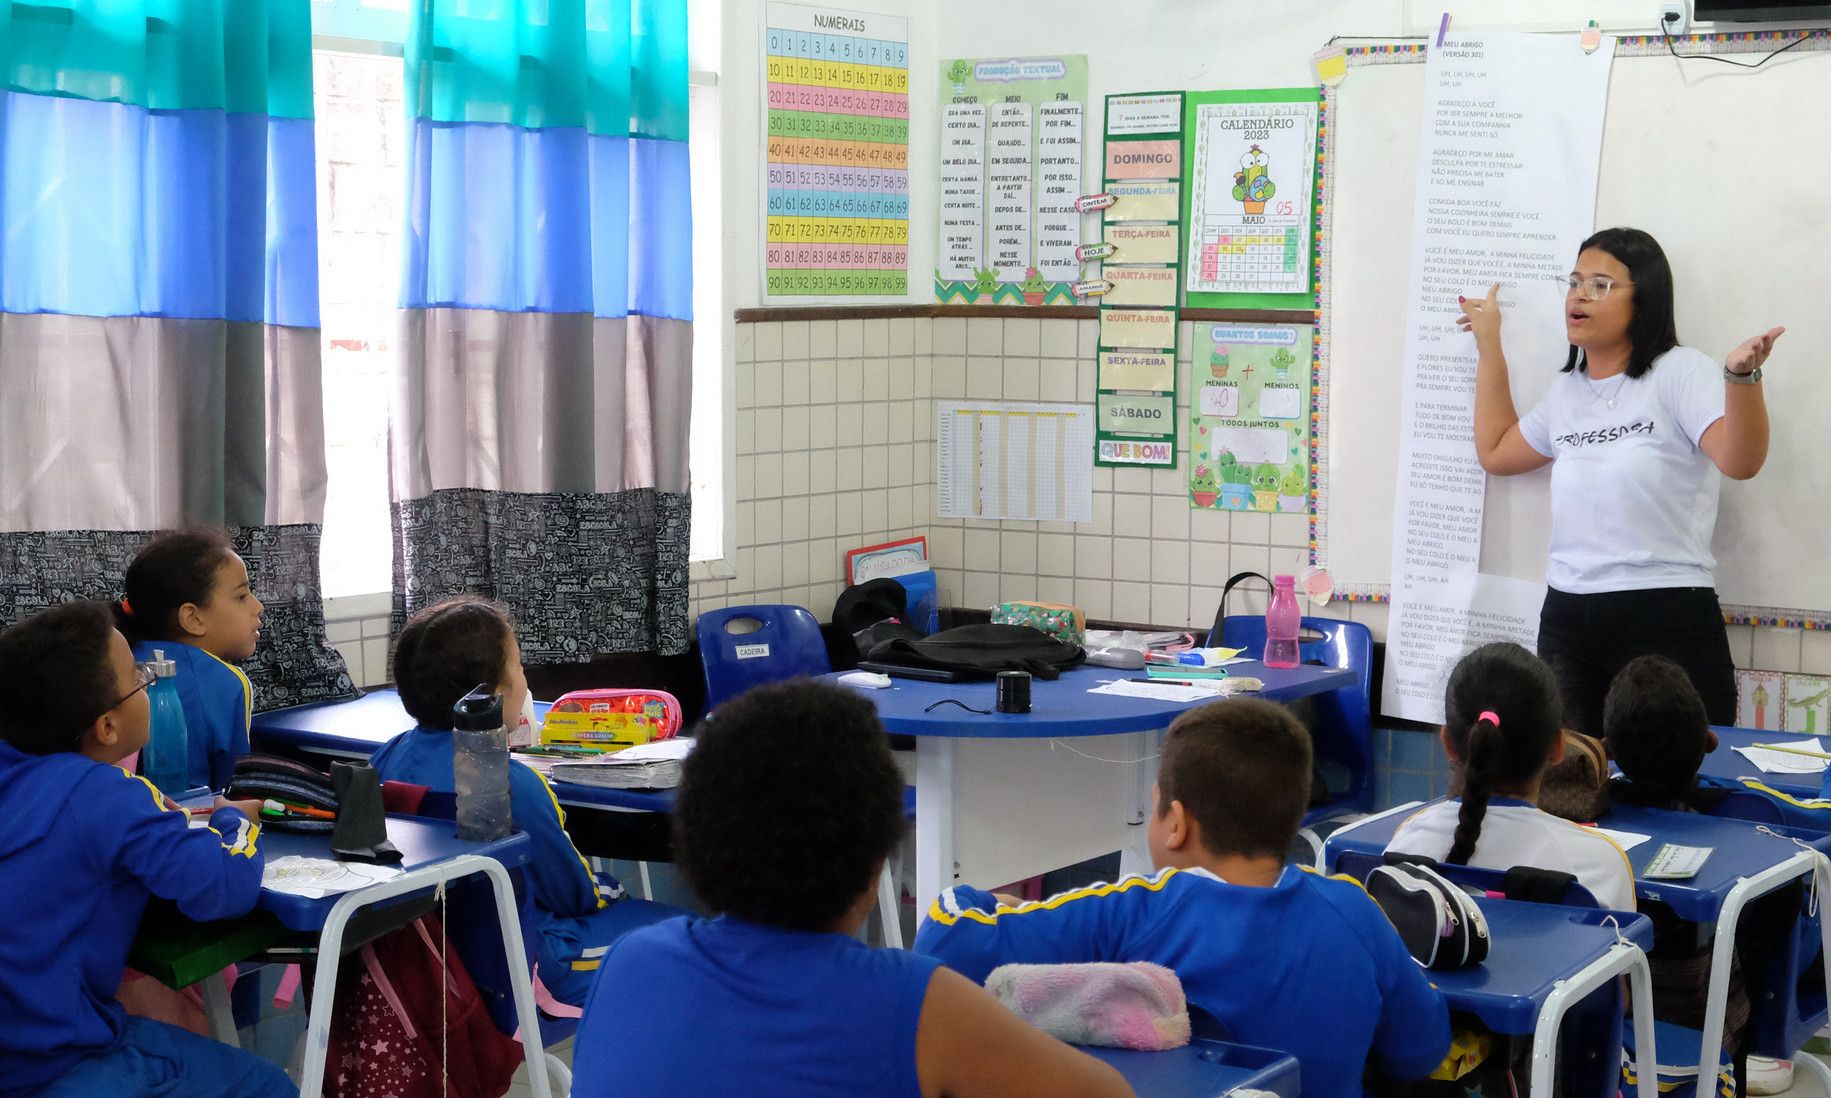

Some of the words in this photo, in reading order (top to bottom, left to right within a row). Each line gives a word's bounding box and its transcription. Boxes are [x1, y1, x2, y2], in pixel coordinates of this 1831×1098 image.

[814, 14, 865, 31] NUMERAIS
[772, 37, 777, 49] 0
[788, 39, 791, 50] 1
[802, 40, 806, 52] 2
[816, 42, 820, 53] 3
[830, 43, 834, 54] 4
[845, 44, 850, 56] 5
[858, 46, 863, 57] 6
[871, 48, 876, 59] 7
[885, 49, 890, 60] 8
[899, 51, 904, 62] 9
[1443, 50, 1469, 58] (VERSÃO
[978, 65, 1020, 76] PRODUÇÃO
[1023, 64, 1061, 74] TEXTUAL
[770, 64, 779, 76] 10
[786, 65, 793, 77] 11
[800, 67, 808, 78] 12
[815, 68, 822, 80] 13
[828, 69, 837, 81] 14
[843, 71, 851, 82] 15
[857, 72, 865, 84] 16
[870, 73, 878, 85] 17
[885, 75, 892, 86] 18
[897, 74, 905, 88] 19
[953, 96, 977, 104] COMEÇO
[1437, 100, 1470, 109] AGRADEÇO
[1479, 100, 1495, 108] VOCÊ
[1496, 112, 1523, 120] MELHOR
[1221, 116, 1294, 129] CALENDÁRIO
[1472, 121, 1511, 129] COMPANHIA
[1244, 130, 1269, 140] 2023
[1433, 149, 1467, 158] AGRADEÇO
[1114, 154, 1172, 164] DOMINGO
[1432, 159, 1463, 167] DESCULPA
[1432, 168, 1445, 176] NÃO
[1083, 199, 1107, 207] ONTEM
[1473, 199, 1489, 207] VOCÊ
[1276, 201, 1292, 215] 05
[1451, 209, 1489, 217] COZINHEIRA
[1242, 216, 1265, 225] MAIO
[1112, 230, 1170, 239] TERÇA-FEIRA
[1523, 232, 1556, 241] APRENDER
[1084, 248, 1104, 256] HOJE
[1496, 251, 1517, 259] MINHA
[1520, 252, 1555, 261] FELICIDADE
[1052, 258, 1071, 266] ENTÃO
[1107, 272, 1173, 280] QUARTA-FEIRA
[769, 277, 780, 288] 90
[784, 277, 793, 288] 91
[798, 277, 808, 288] 92
[812, 277, 823, 288] 93
[827, 277, 837, 289] 94
[841, 277, 851, 289] 95
[855, 277, 865, 289] 96
[868, 277, 878, 289] 97
[882, 277, 892, 289] 98
[895, 277, 905, 289] 99
[1107, 314, 1170, 323] QUINTA-FEIRA
[1215, 330, 1255, 338] QUANTOS
[1257, 331, 1294, 340] SOMOS?
[1108, 357, 1166, 366] SEXTA-FEIRA
[1111, 406, 1161, 418] SÁBADO
[1102, 442, 1129, 458] QUE
[1133, 444, 1170, 460] BOM!
[1422, 541, 1443, 549] ABRIGO
[556, 584, 590, 593] ESCOLA
[739, 647, 765, 656] CADEIRA
